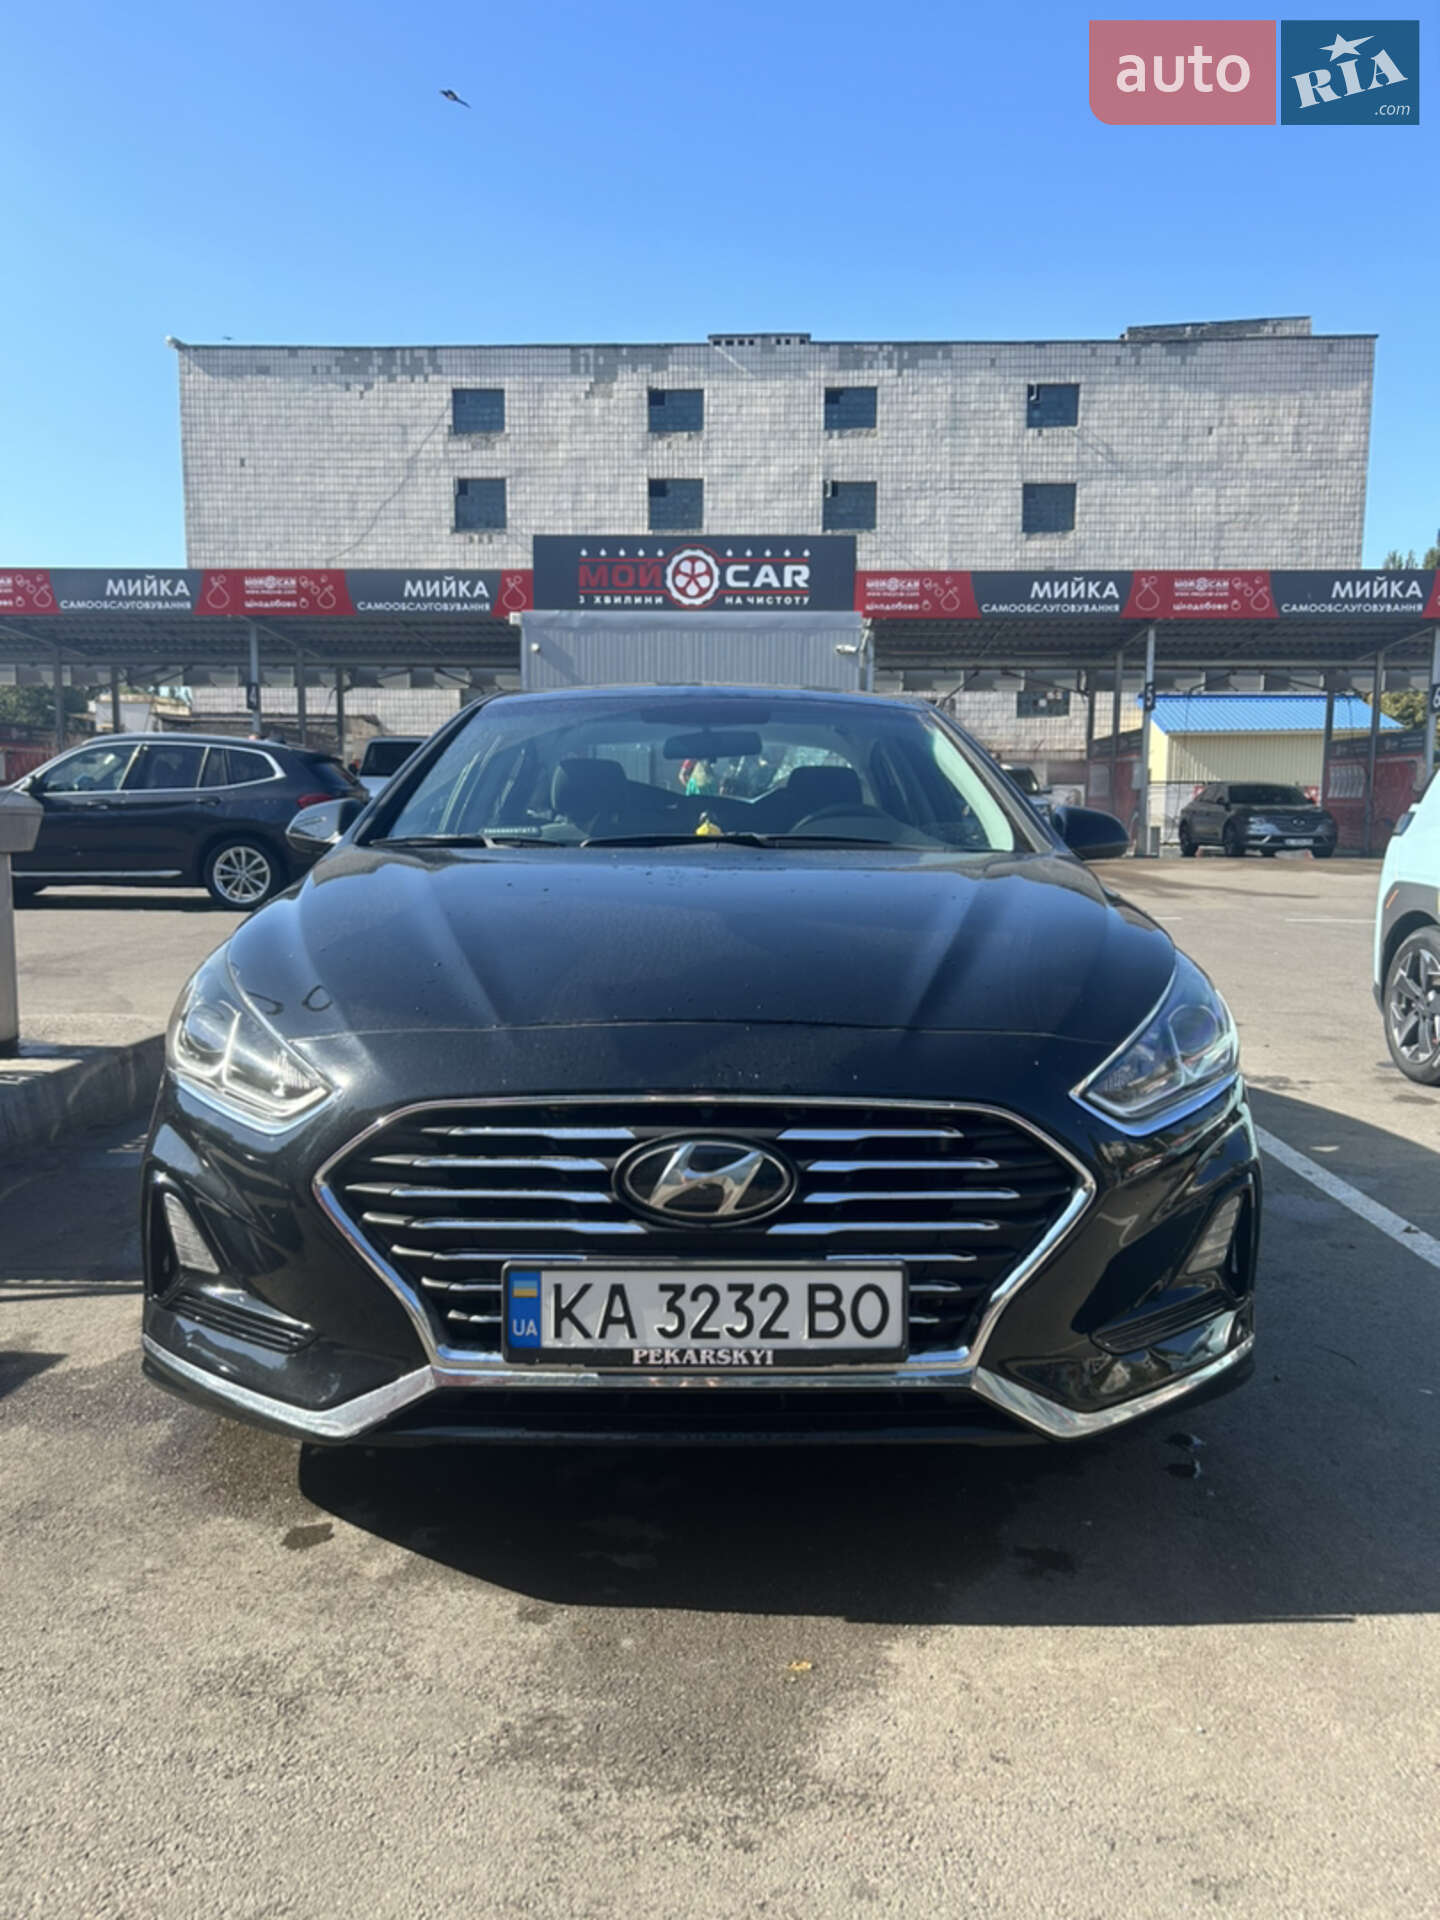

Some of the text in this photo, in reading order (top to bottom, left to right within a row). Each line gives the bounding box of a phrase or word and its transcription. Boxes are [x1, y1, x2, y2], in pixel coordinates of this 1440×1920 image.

[579, 562, 810, 588] МОЙ CAR
[106, 575, 191, 597] МИЙКА
[404, 576, 490, 598] МИЙКА
[1030, 577, 1120, 599] МИЙКА
[1331, 576, 1424, 599] МИЙКА
[60, 600, 192, 610] САМООБСЛУГОВУВАННЯ
[357, 602, 491, 612] САМООБСЛУГОВУВАННЯ
[594, 596, 664, 605] ХВИЛИНИ
[725, 596, 743, 605] НА
[747, 596, 810, 605] ЧИСТОТУ
[981, 603, 1120, 613] САМООБСЛУГОВУВАННЯ
[1281, 603, 1424, 613] САМООБСЛУГОВУВАННЯ
[553, 1283, 890, 1339] KA 3232 BO
[513, 1320, 538, 1337] UA
[632, 1349, 775, 1366] PEKARSKYI
